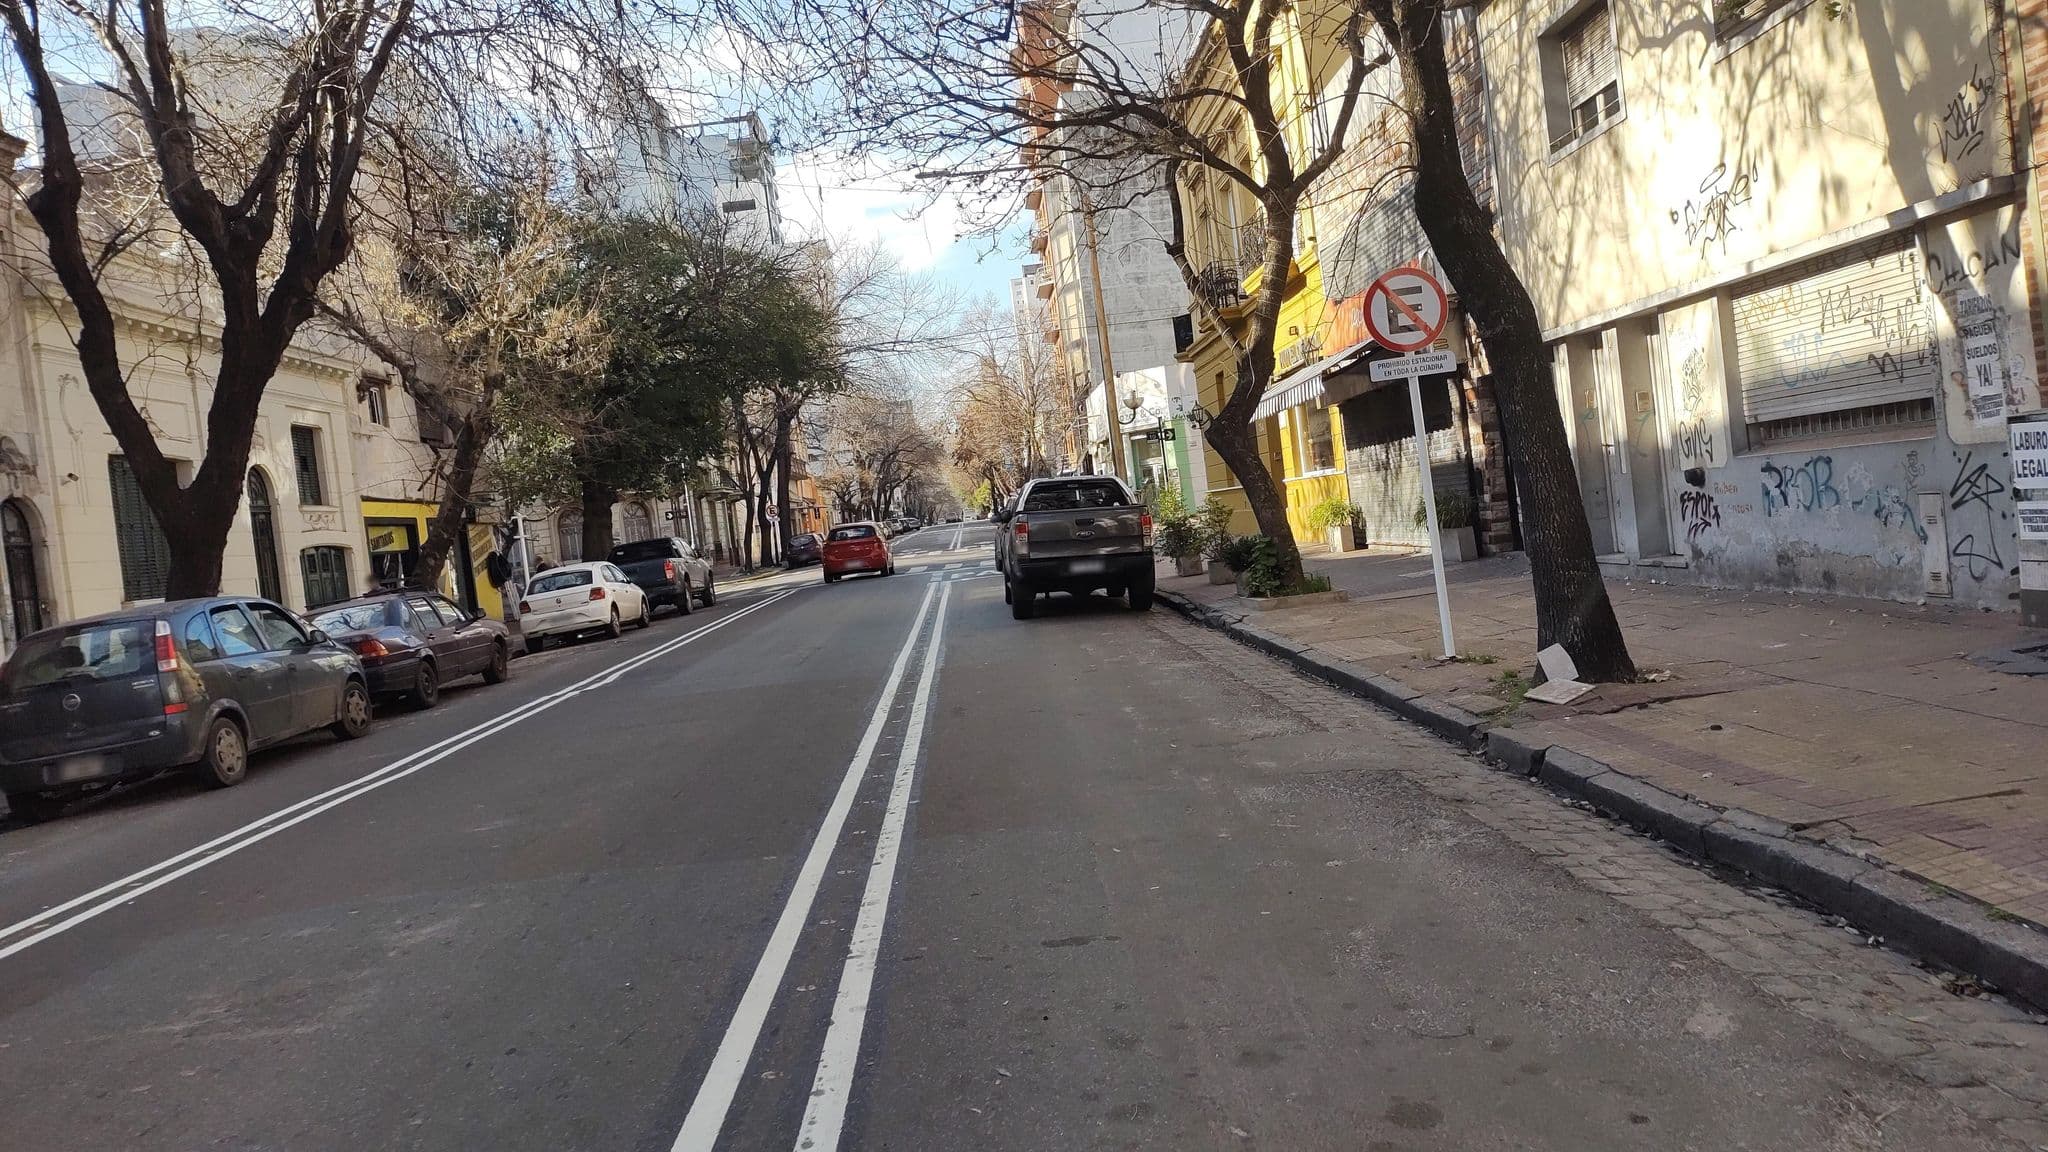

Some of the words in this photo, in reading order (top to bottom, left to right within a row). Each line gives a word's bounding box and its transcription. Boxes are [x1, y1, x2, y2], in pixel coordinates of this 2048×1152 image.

[1966, 343, 1998, 360] SUELDOS
[1377, 359, 1411, 370] PROHIBIDO
[1411, 354, 1448, 365] ESTACIONAR
[1419, 363, 1444, 372] CUADRA
[1975, 362, 1994, 387] YA!
[2013, 431, 2048, 451] LABURO
[2015, 458, 2048, 478] LEGAL
